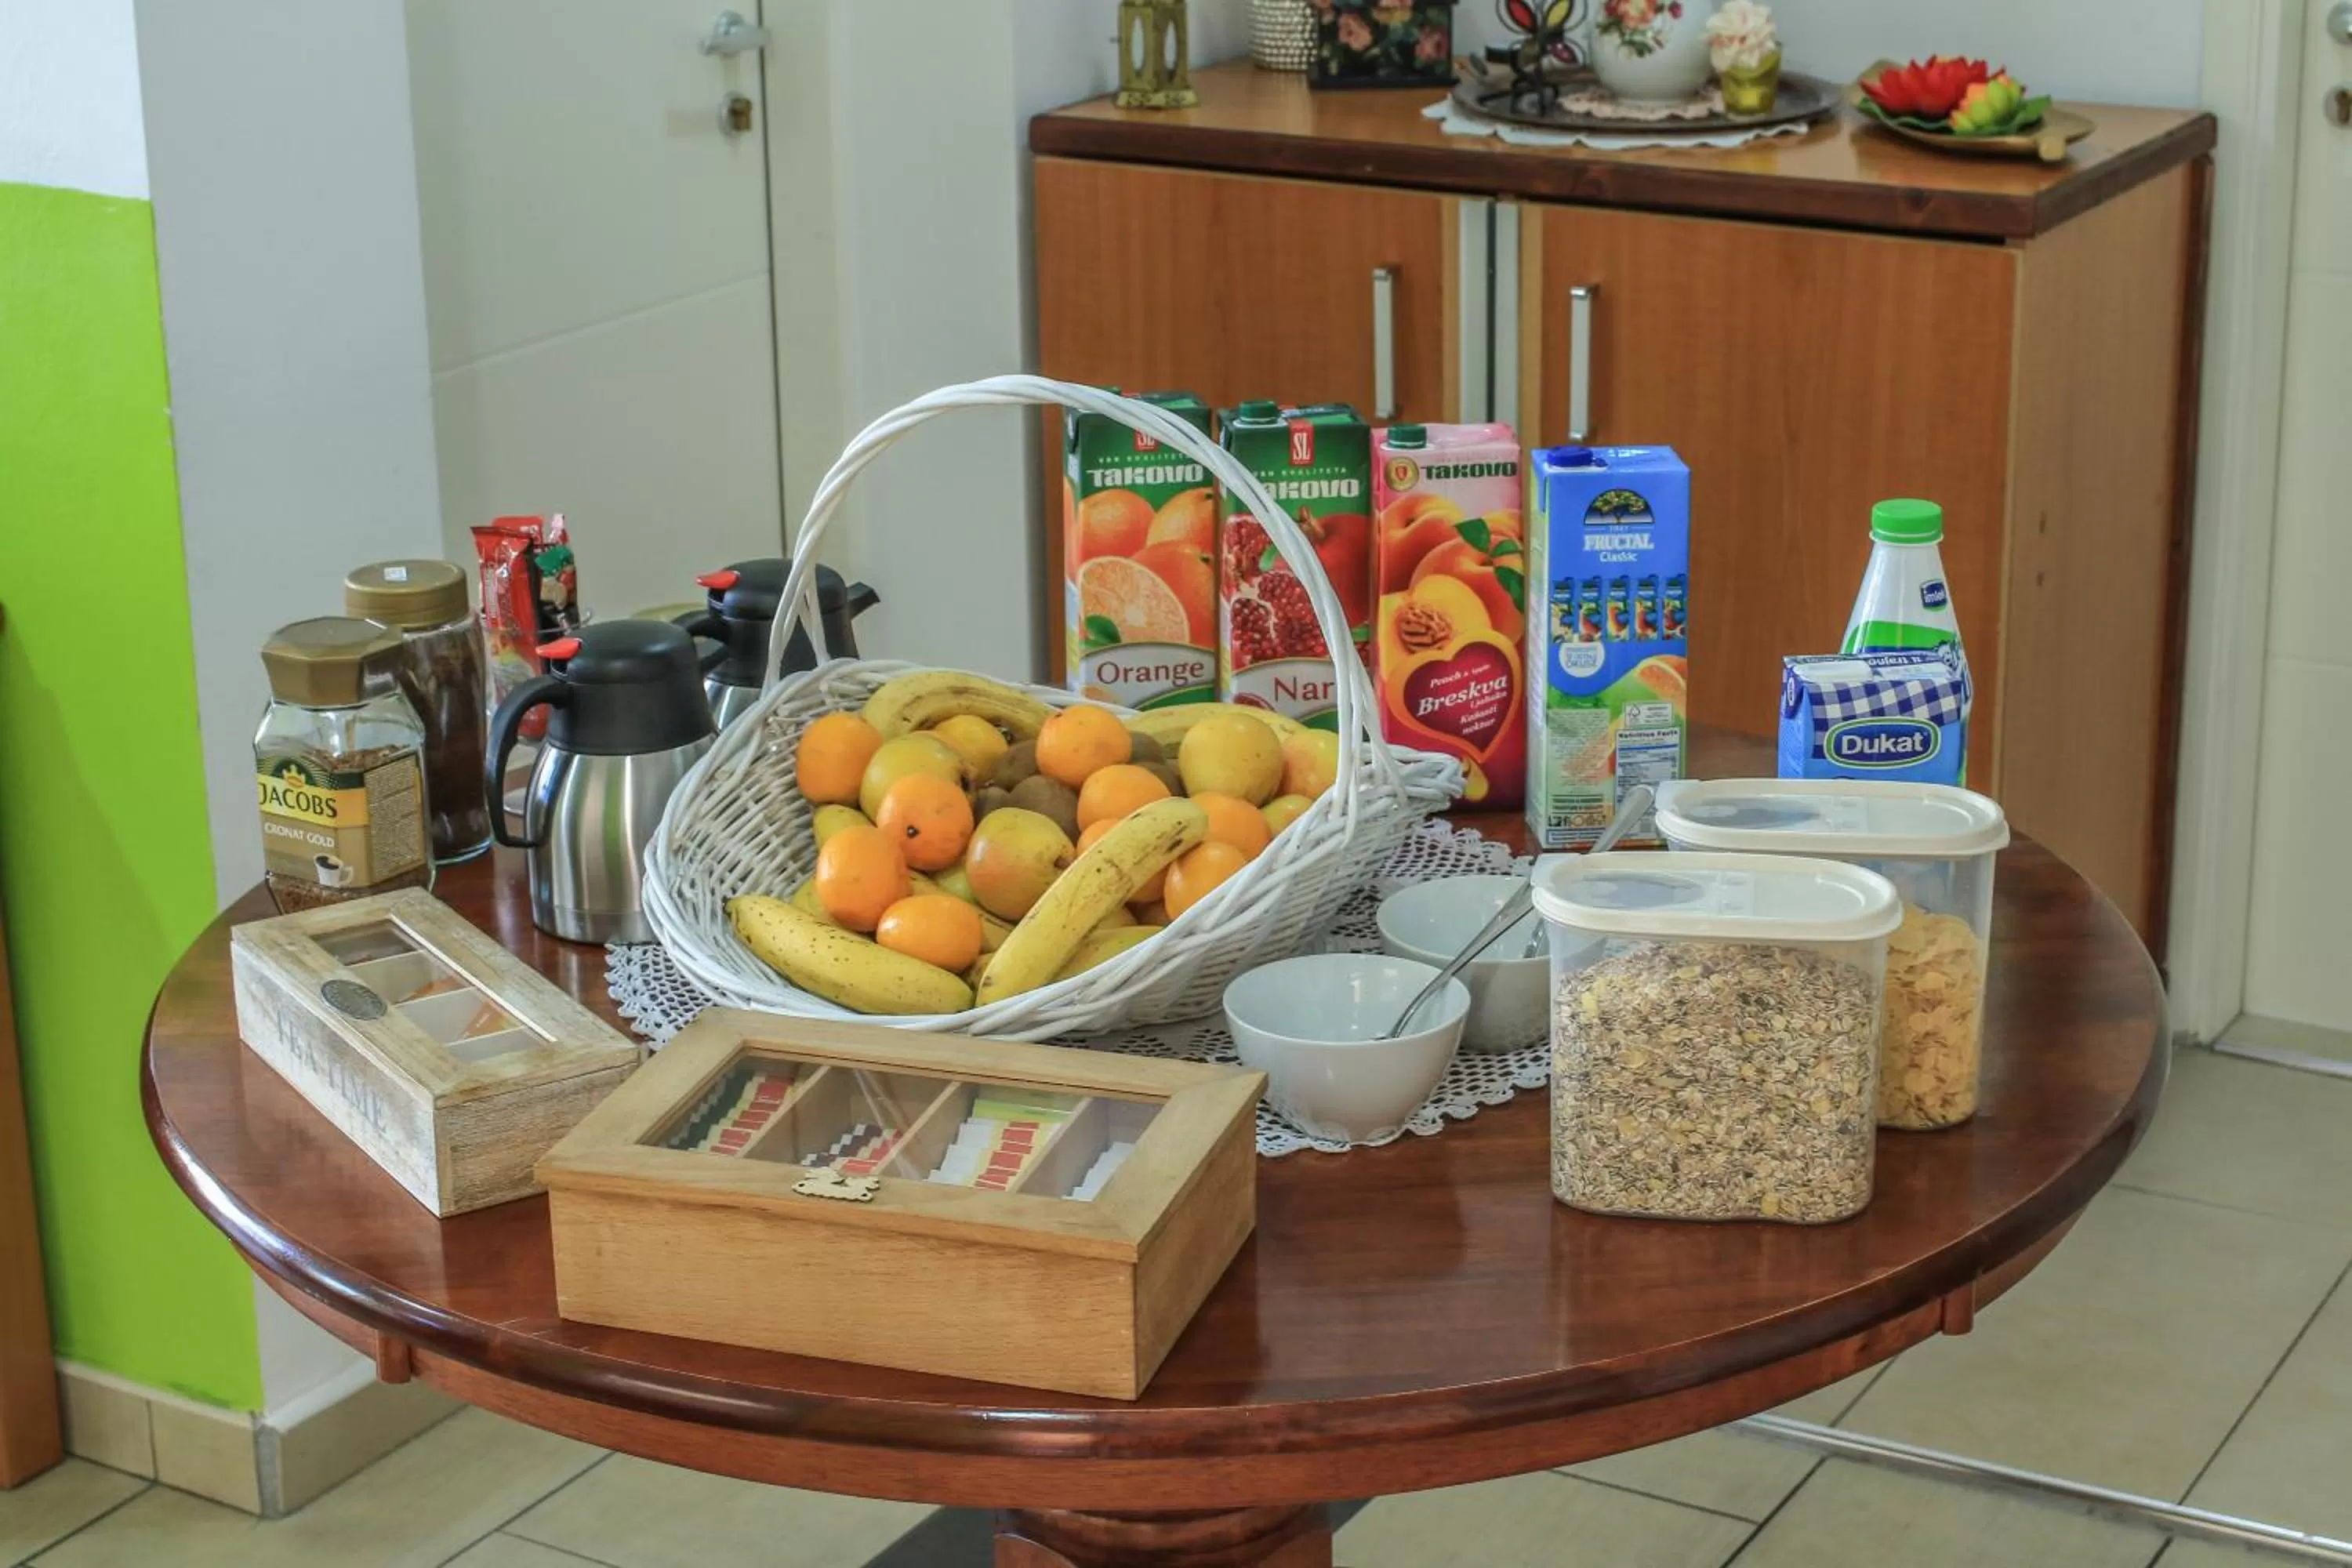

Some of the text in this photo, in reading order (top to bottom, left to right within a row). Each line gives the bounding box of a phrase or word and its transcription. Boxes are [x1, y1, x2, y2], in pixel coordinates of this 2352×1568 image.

[1292, 431, 1311, 461] SL
[1582, 532, 1656, 552] FRUCTAL
[1599, 550, 1639, 563] Classic
[1097, 660, 1205, 687] Orange
[1429, 670, 1462, 689] Peach
[1273, 676, 1336, 702] Nar
[1417, 675, 1508, 717] Breskva
[1841, 731, 1924, 755] Dukat
[260, 782, 338, 818] JACOBS
[307, 832, 336, 848] GOLD
